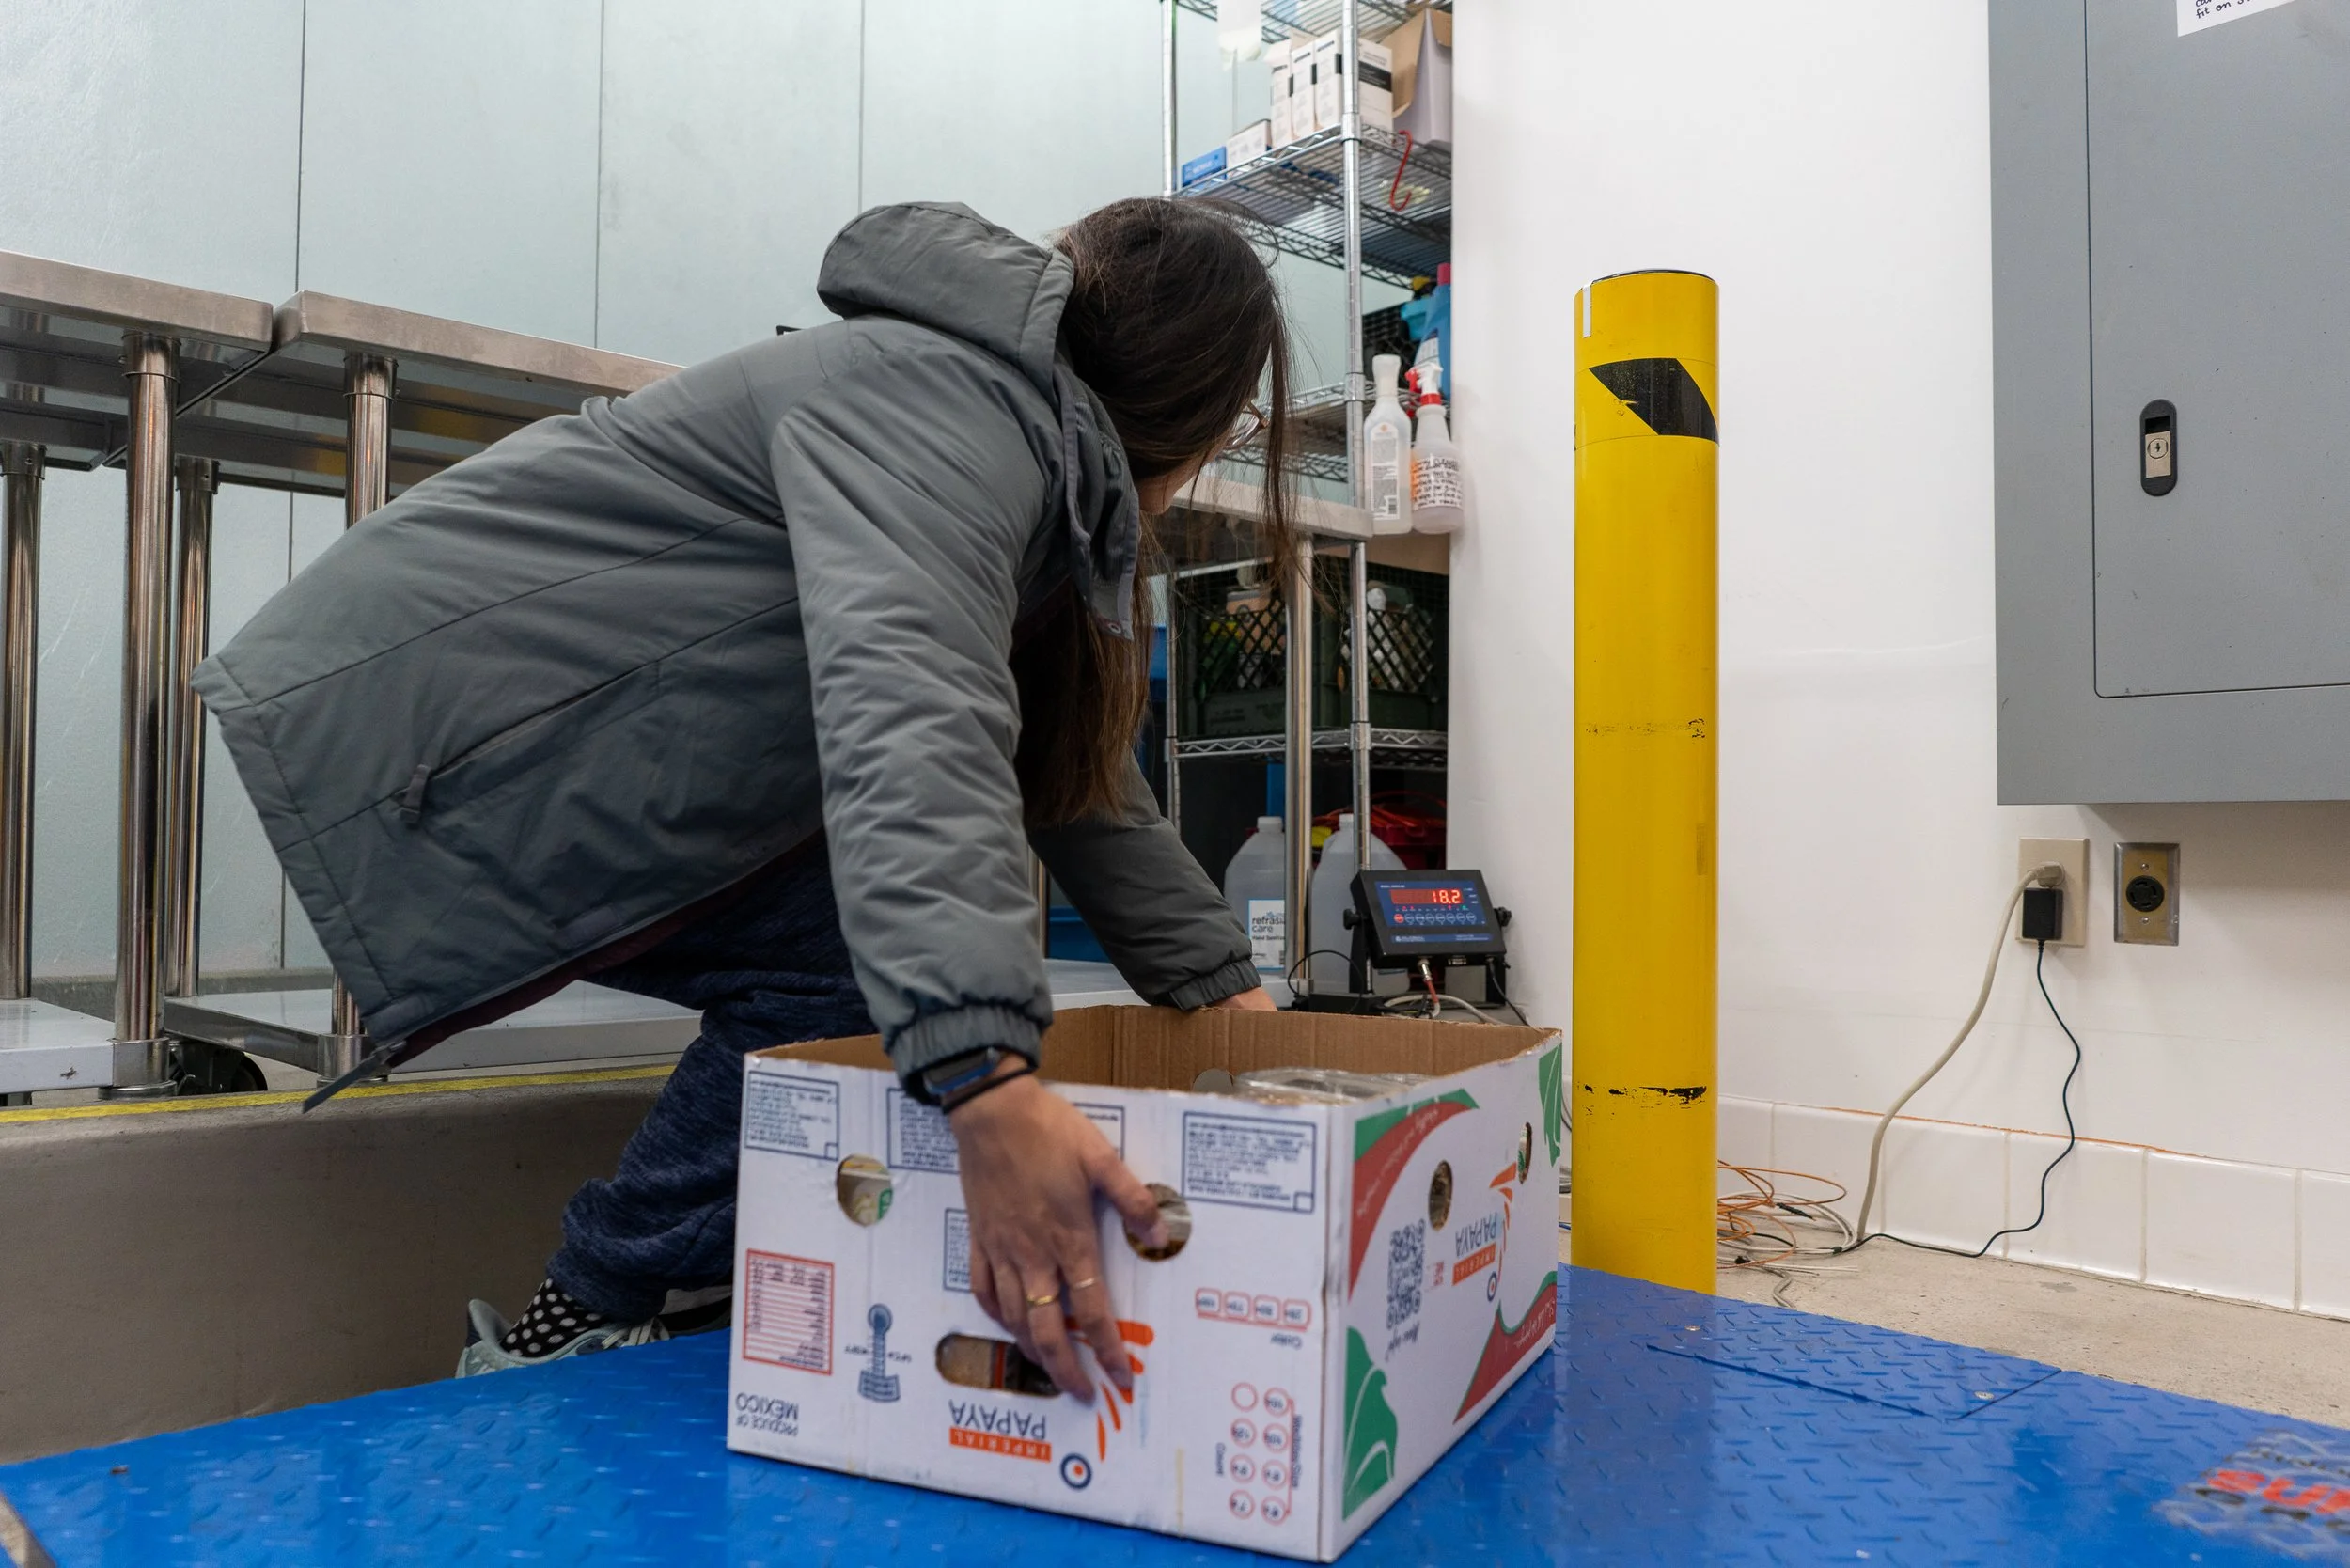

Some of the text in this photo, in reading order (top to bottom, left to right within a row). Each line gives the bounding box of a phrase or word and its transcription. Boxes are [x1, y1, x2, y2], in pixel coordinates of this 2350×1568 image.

[2196, 1, 2232, 19] fit on
[1432, 889, 1461, 904] 18.2
[1454, 1211, 1497, 1257] PAPAYA
[948, 1398, 1046, 1440] PAPAYA
[954, 1430, 1047, 1459] IMPERIAL
